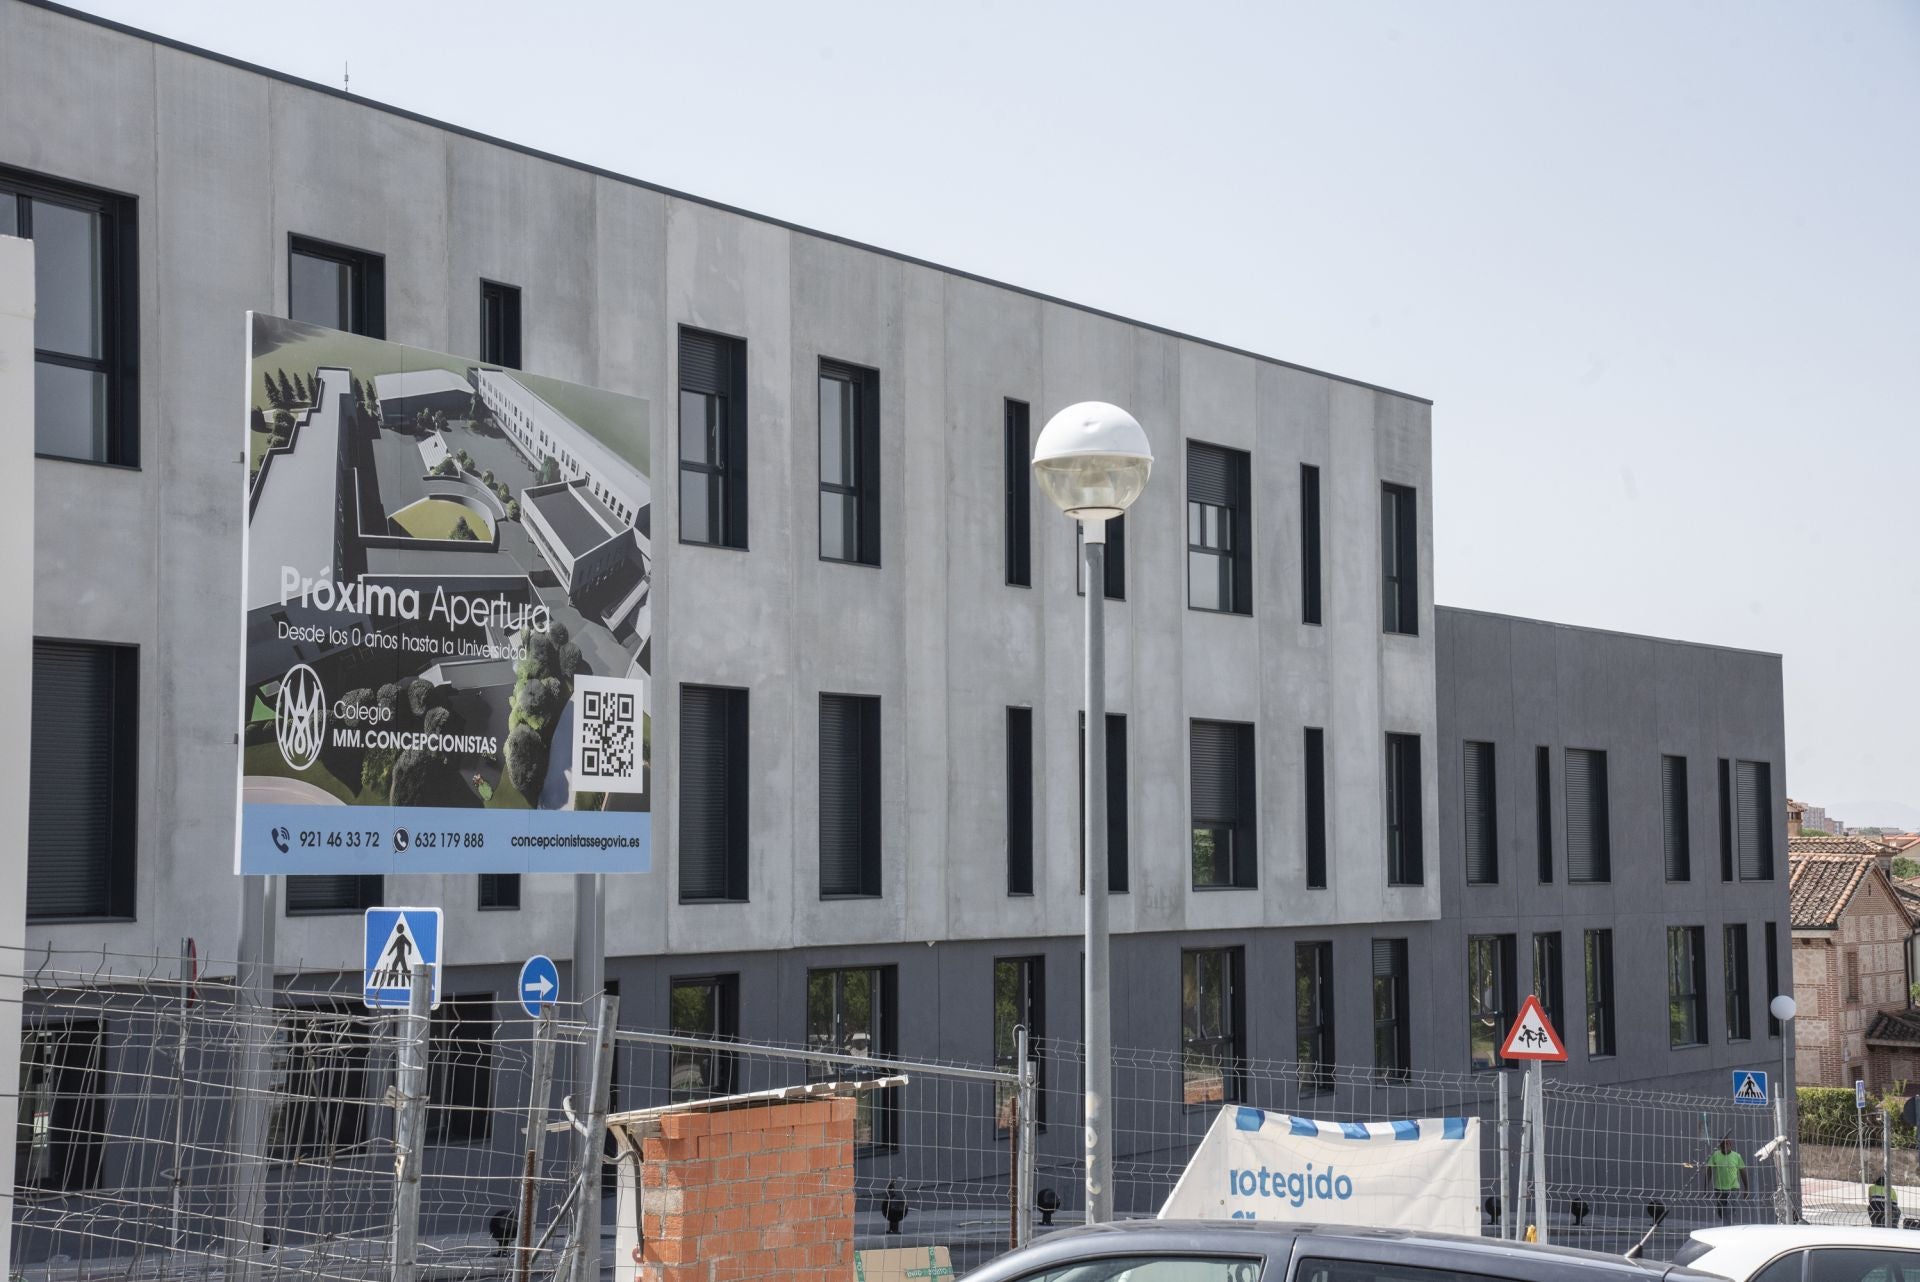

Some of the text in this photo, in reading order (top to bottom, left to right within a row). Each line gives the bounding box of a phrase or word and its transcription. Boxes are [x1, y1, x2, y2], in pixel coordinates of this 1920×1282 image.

[280, 565, 550, 633] Próxima Apertura
[278, 621, 528, 660] Desde los 0 años hasta la Universidad
[333, 700, 392, 725] Colegio
[332, 728, 497, 754] MM.CONCEPCIONISTAS
[300, 831, 380, 848] 921 46 33 72
[415, 832, 484, 848] 632 179 888
[511, 834, 640, 850] concepcionistassegovia.es
